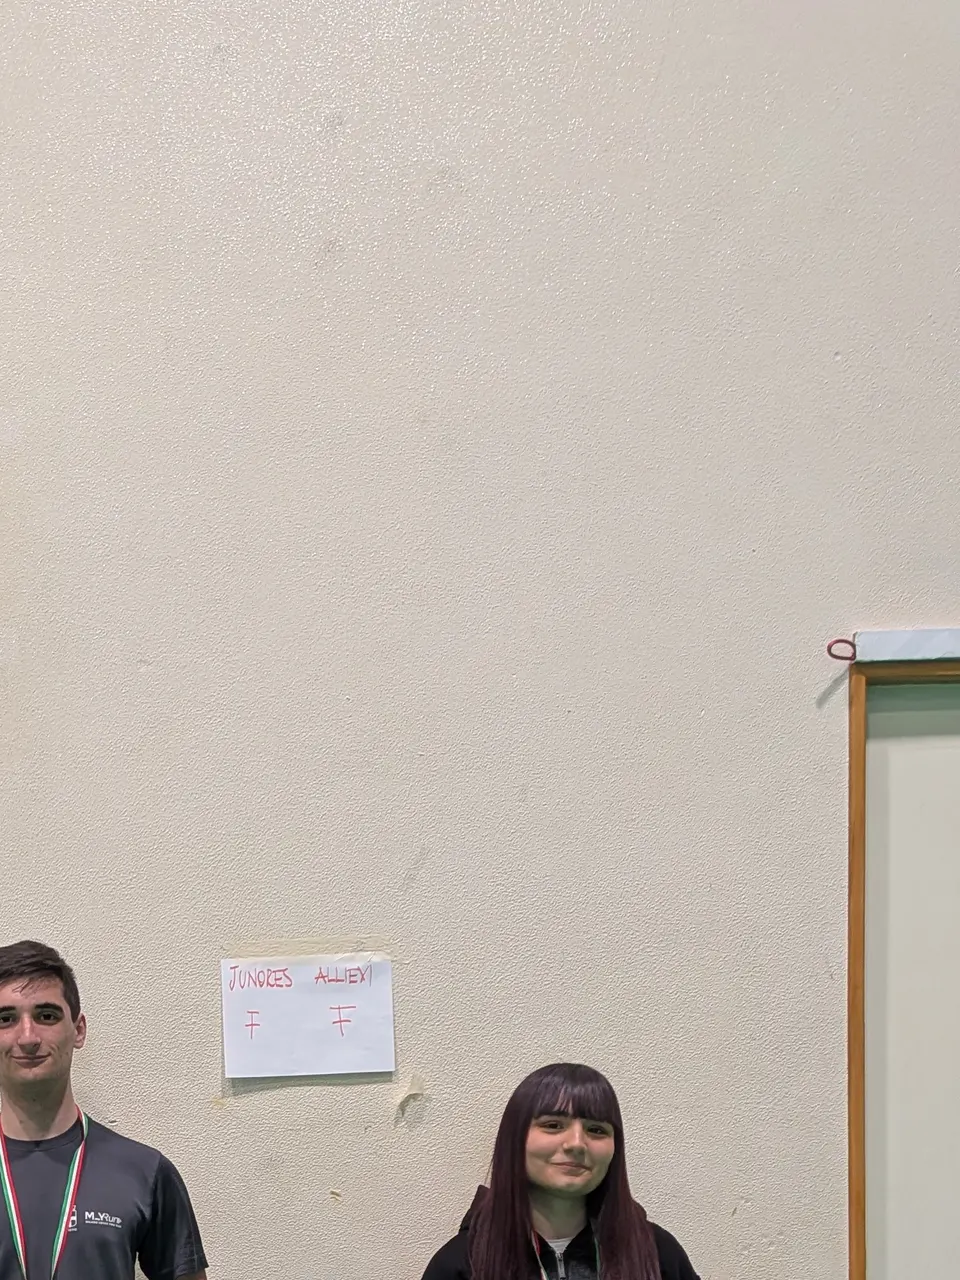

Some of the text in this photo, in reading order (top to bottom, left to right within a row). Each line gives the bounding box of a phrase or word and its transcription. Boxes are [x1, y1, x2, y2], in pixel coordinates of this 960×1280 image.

[314, 964, 373, 987] ALLIEVI
[245, 1005, 357, 1040] F F
